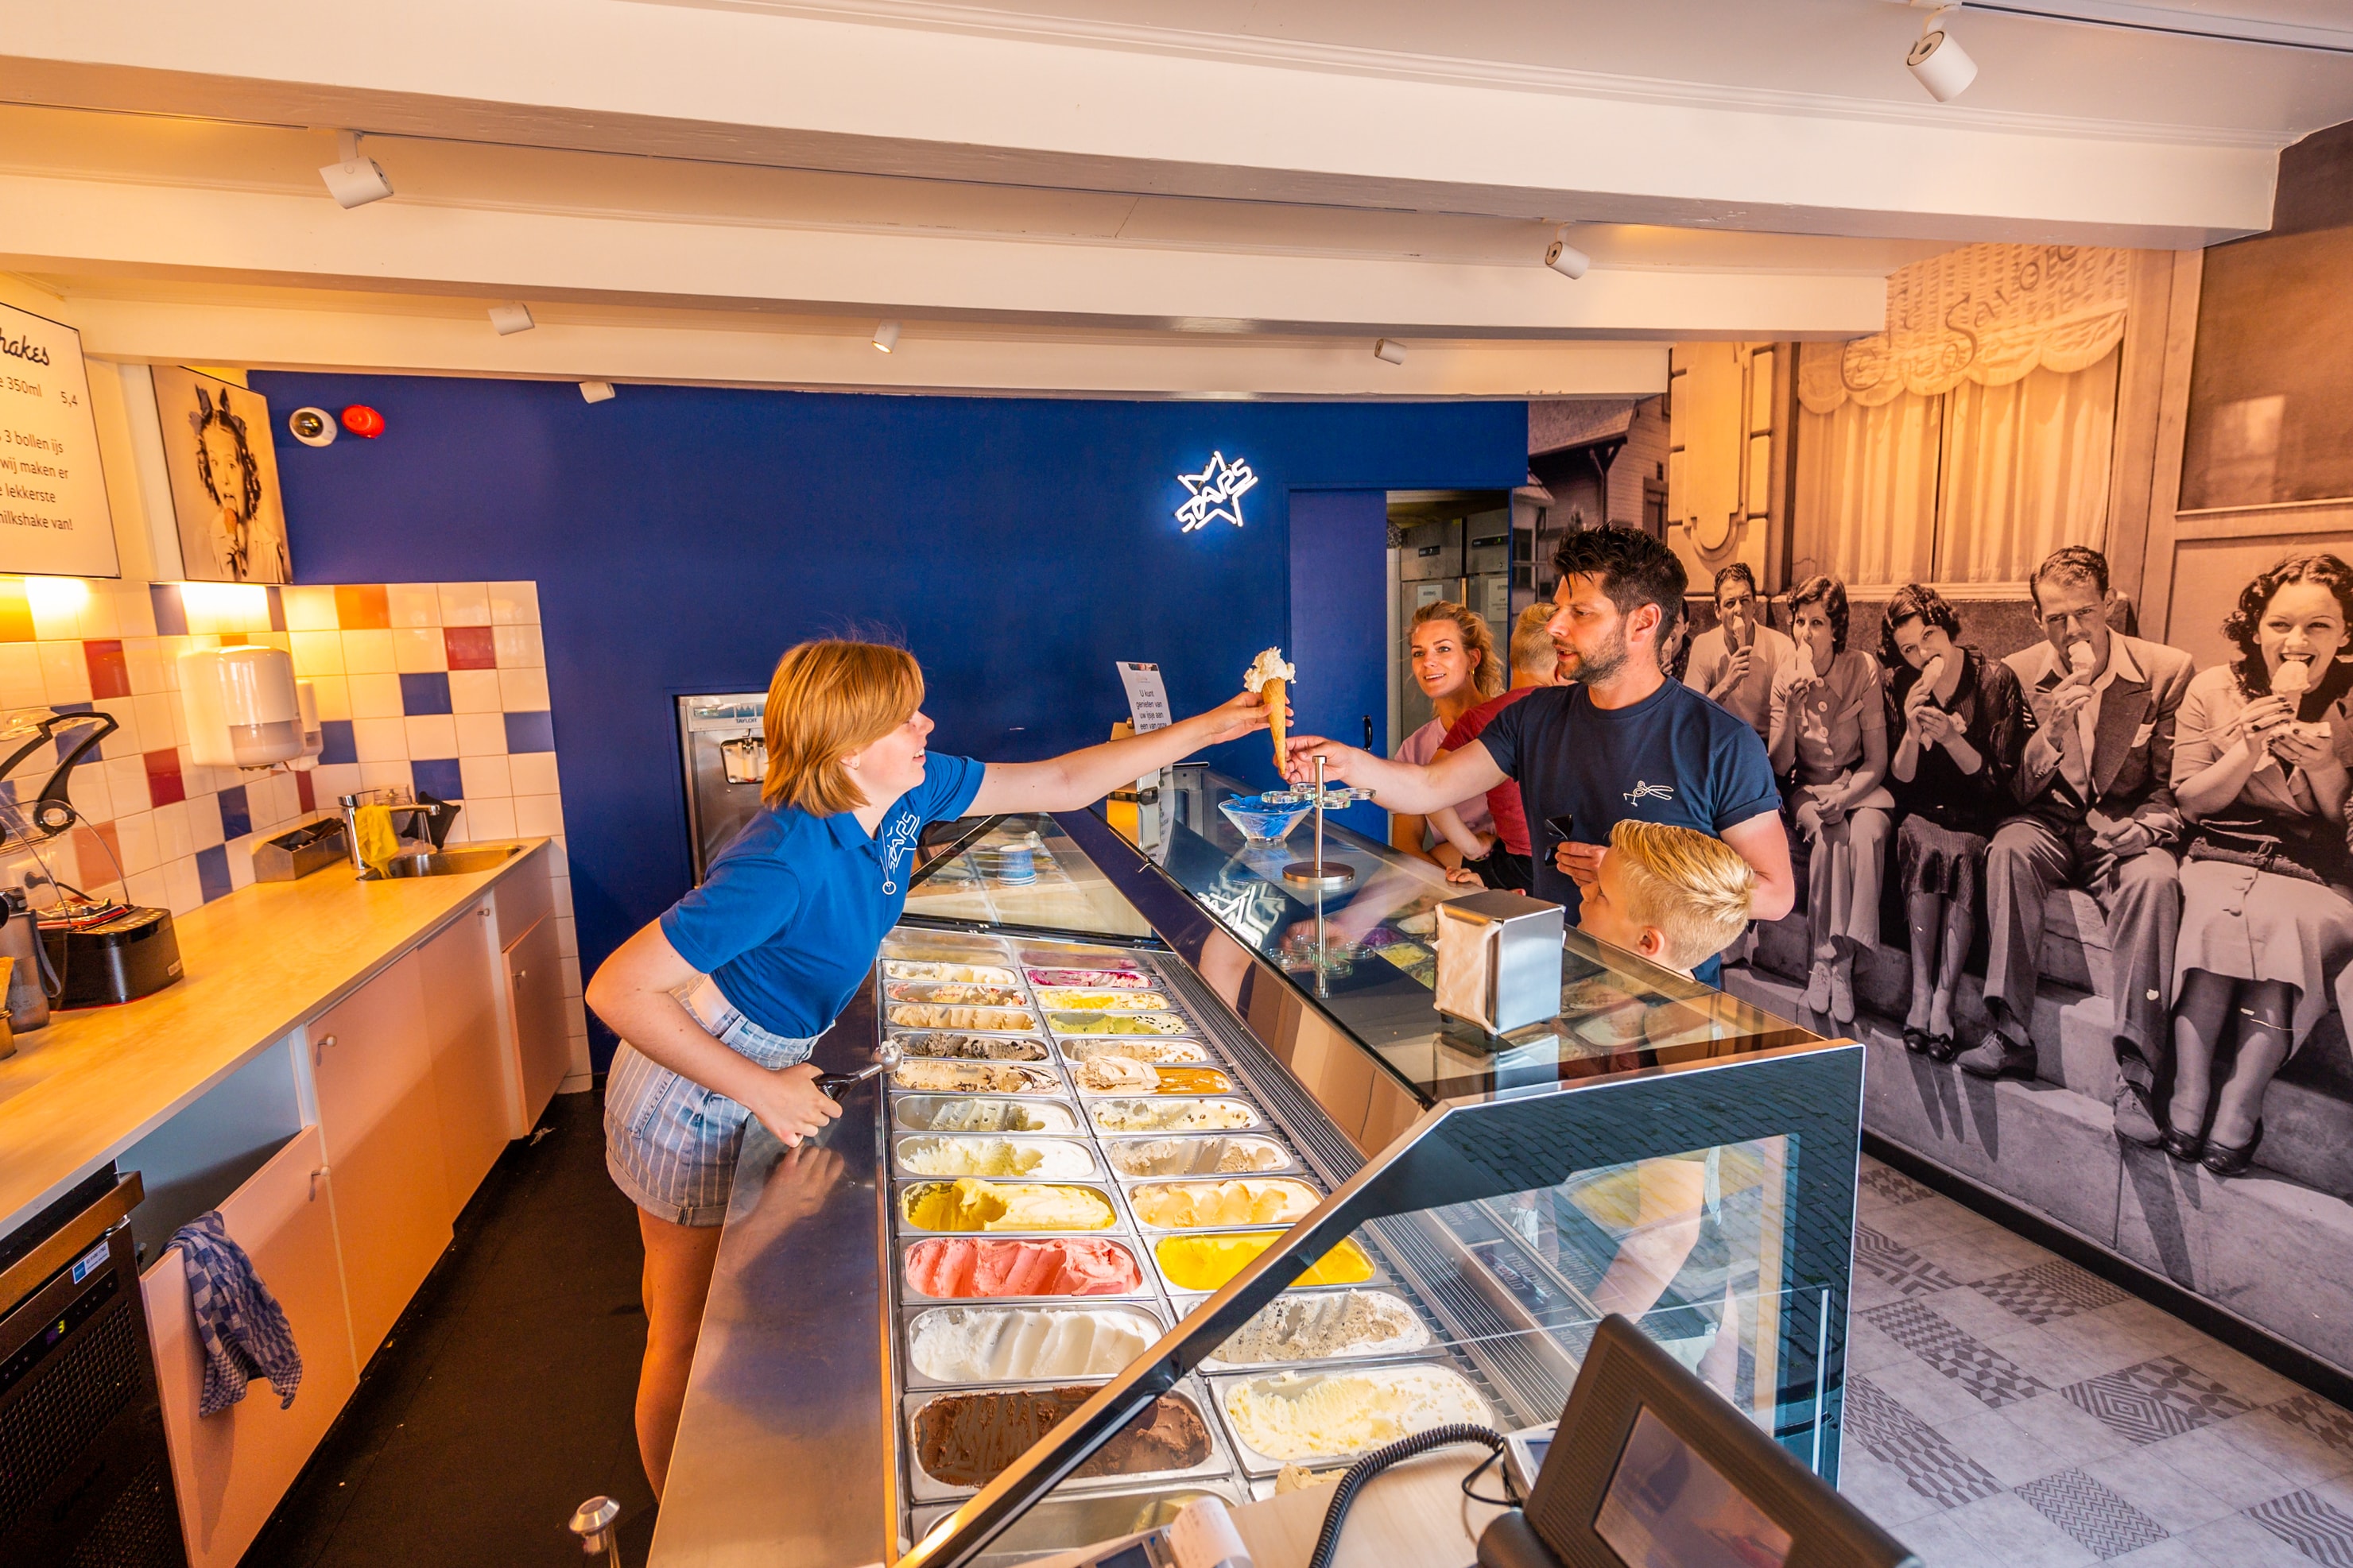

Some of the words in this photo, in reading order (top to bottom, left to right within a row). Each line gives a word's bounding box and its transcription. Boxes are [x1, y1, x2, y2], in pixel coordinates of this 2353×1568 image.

[0, 327, 50, 366] hakes
[6, 376, 42, 397] 350ml
[60, 391, 78, 408] 5,4
[4, 429, 12, 443] 3
[14, 431, 49, 451] bollen
[50, 439, 64, 455] ijs
[0, 456, 17, 474] wij
[20, 461, 56, 477] maken
[59, 469, 69, 479] er
[5, 482, 56, 503] lekkerste
[51, 517, 73, 531] van!
[1145, 689, 1154, 698] kunt
[1136, 700, 1154, 710] genieten
[58, 1319, 65, 1334] 3
